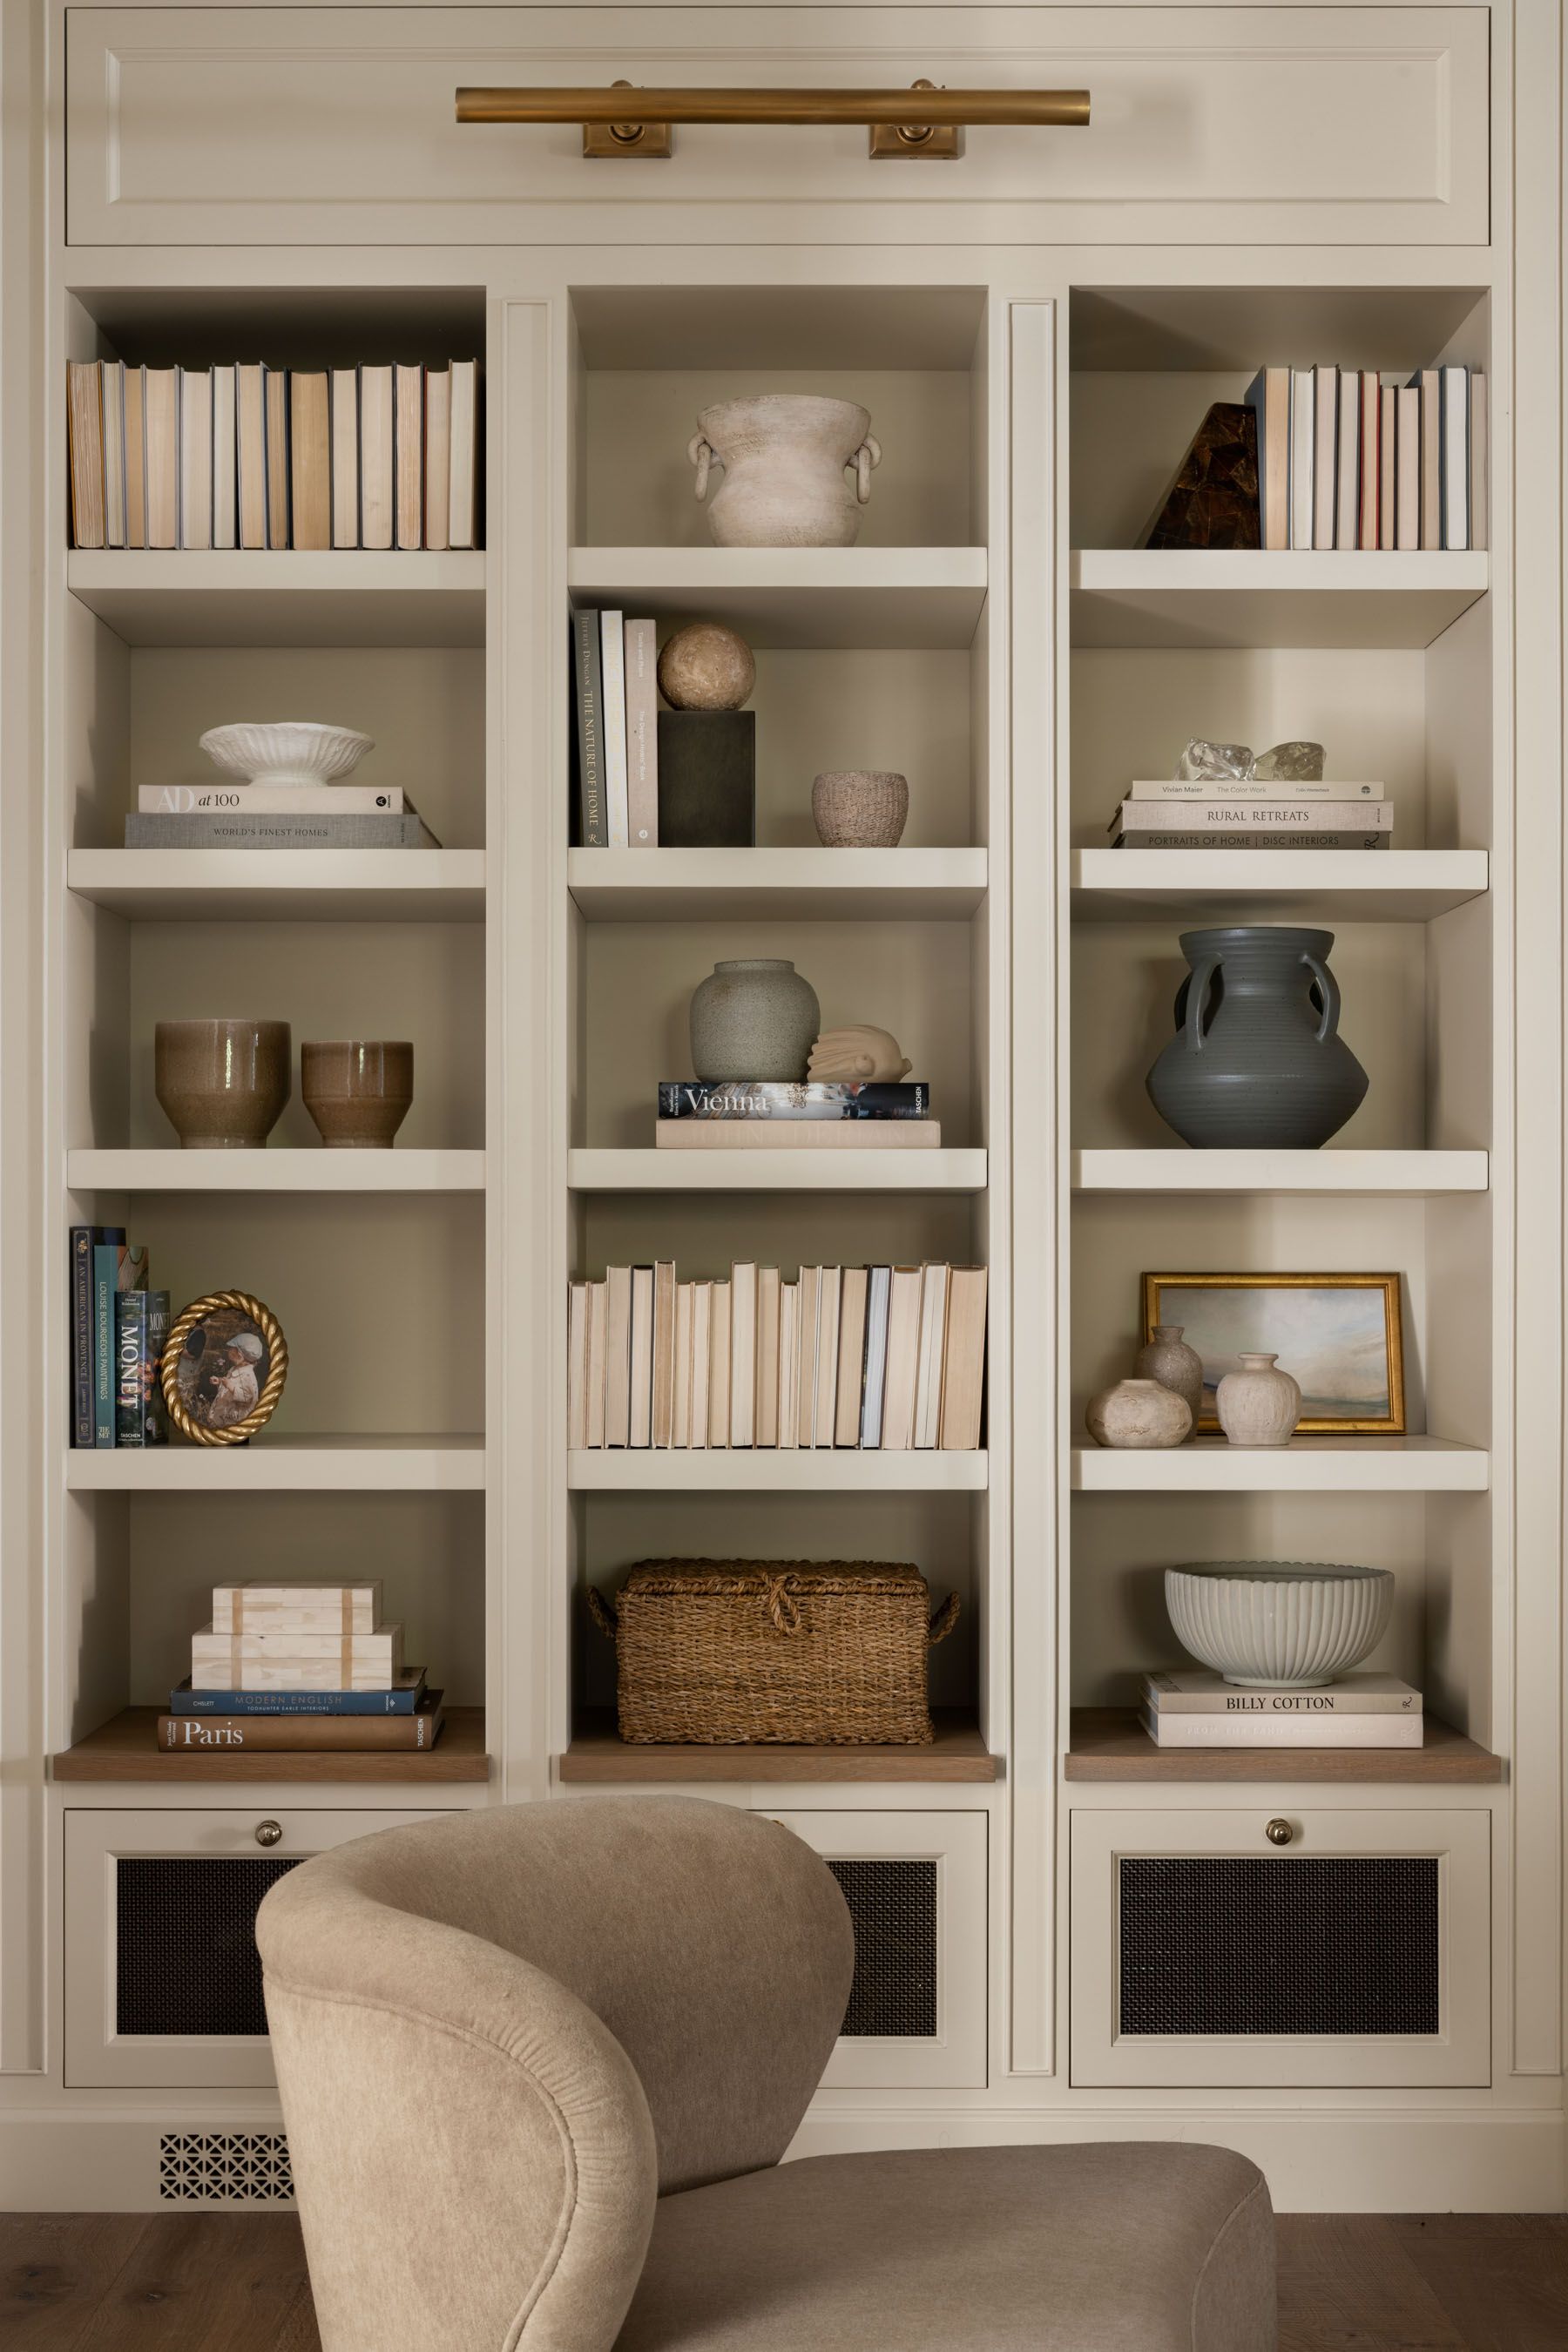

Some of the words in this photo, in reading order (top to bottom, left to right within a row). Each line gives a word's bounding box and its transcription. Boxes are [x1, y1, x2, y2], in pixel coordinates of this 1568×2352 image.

[584, 691, 593, 715] THE
[585, 719, 595, 767] NATURE
[586, 770, 596, 785] OF
[158, 787, 194, 813] AD
[199, 794, 211, 807] at
[214, 794, 240, 807] 100
[588, 790, 598, 827] HOME
[1207, 811, 1247, 821] RURAL
[1253, 811, 1309, 821] RETREATS
[260, 828, 292, 836] FINEST
[1149, 836, 1199, 845] PORTRAITS
[1203, 836, 1217, 845] OF
[1220, 836, 1251, 845] HOME
[1263, 836, 1286, 845] DISC
[1289, 836, 1339, 845] INTERIORS
[685, 1089, 768, 1111] Vienna
[78, 1265, 85, 1277] AN
[79, 1323, 87, 1332] IN
[121, 1326, 139, 1409] MONET
[235, 1696, 285, 1705] MODERN
[291, 1696, 342, 1705] ENGLISH
[1227, 1698, 1267, 1709] BILLY
[1273, 1697, 1335, 1709] COTTON
[183, 1721, 243, 1745] Paris
